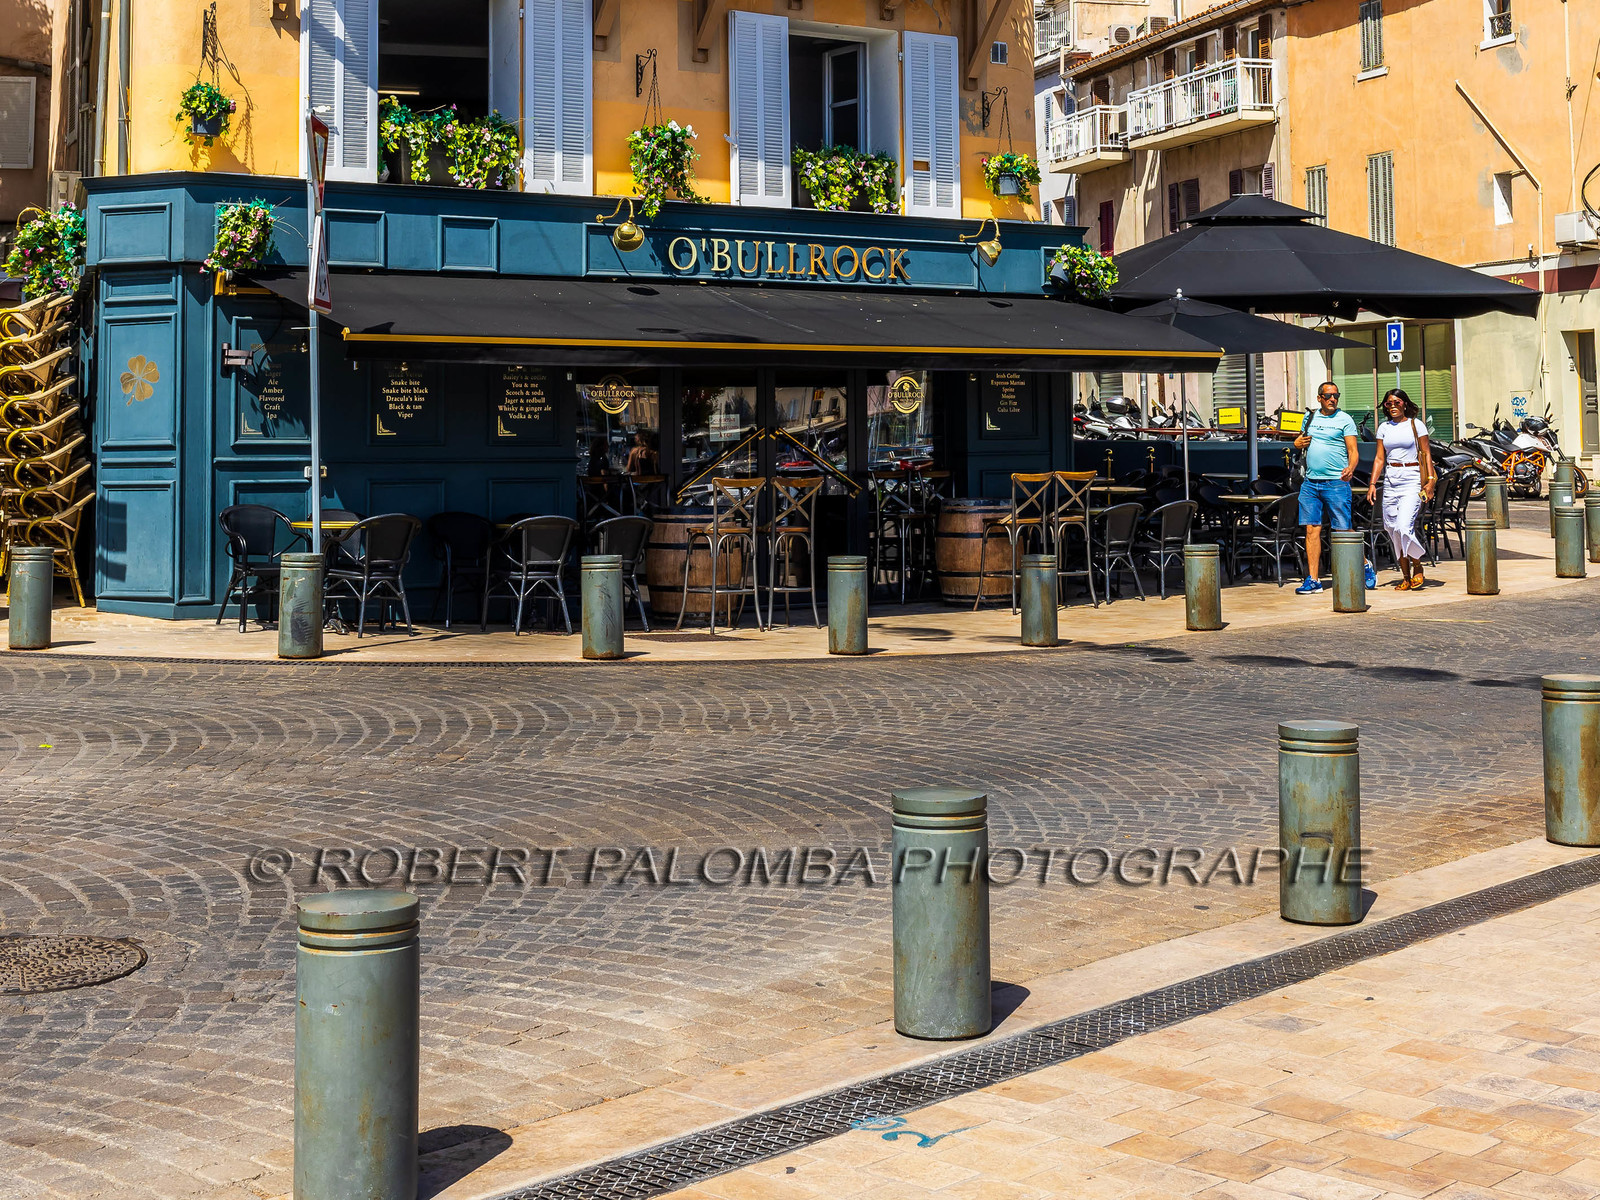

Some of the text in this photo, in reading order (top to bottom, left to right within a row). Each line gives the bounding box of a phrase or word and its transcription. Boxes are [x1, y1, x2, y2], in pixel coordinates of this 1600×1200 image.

[668, 236, 912, 280] O'BULLROCK
[1391, 328, 1398, 347] P
[590, 390, 636, 398] O'BULLROCK
[887, 391, 926, 399] O'BULLROCK
[525, 405, 543, 413] ginger
[267, 412, 277, 420] Ipa
[397, 411, 413, 419] Viper
